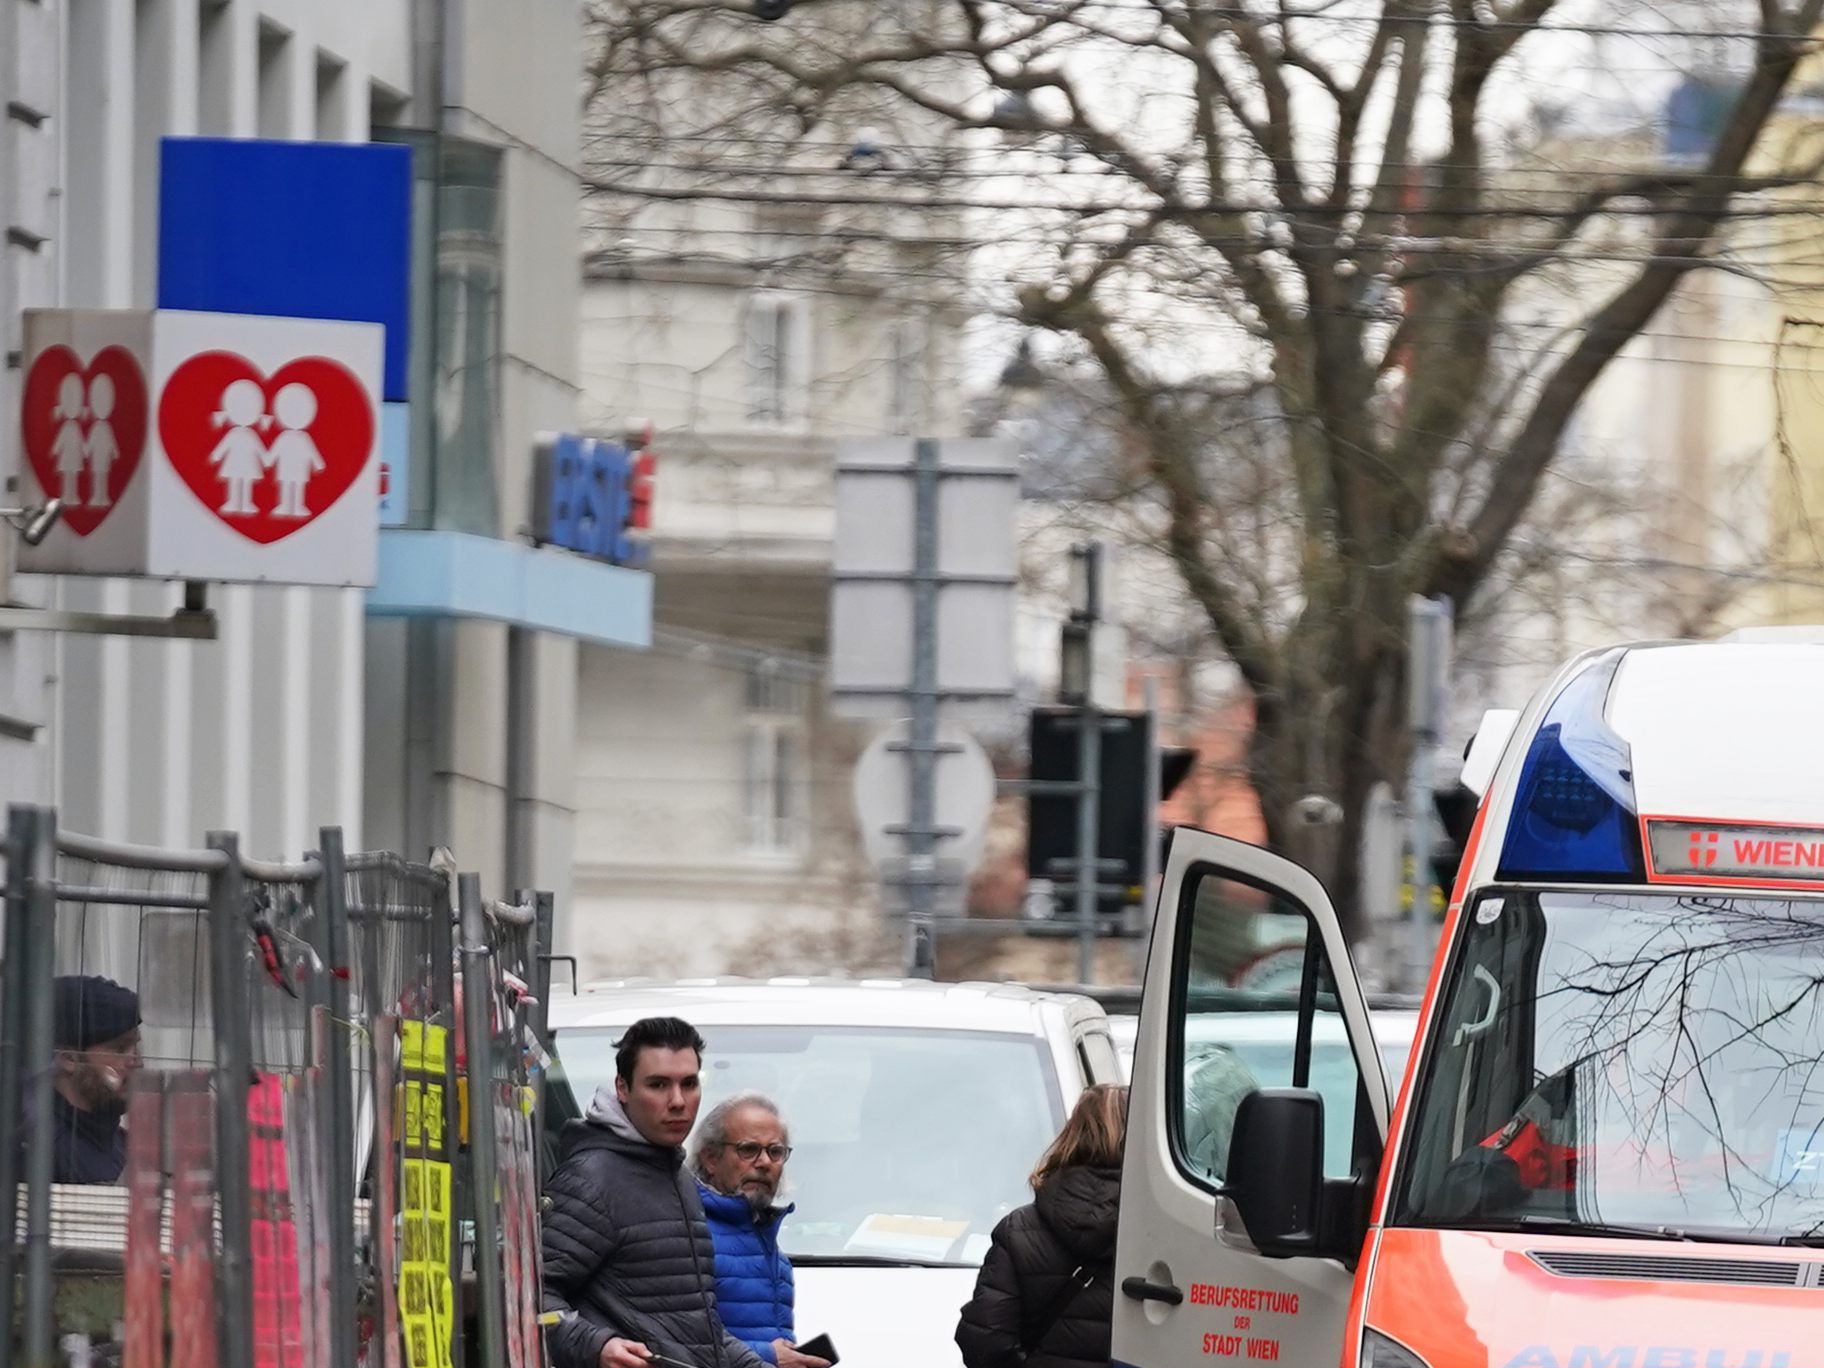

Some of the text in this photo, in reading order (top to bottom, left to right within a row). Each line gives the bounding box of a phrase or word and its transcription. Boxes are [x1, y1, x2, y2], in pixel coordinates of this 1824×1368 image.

[1190, 1283, 1299, 1315] BERUFSRETTUNG
[1234, 1316, 1251, 1330] DER
[1202, 1333, 1279, 1361] STADT WIEN
